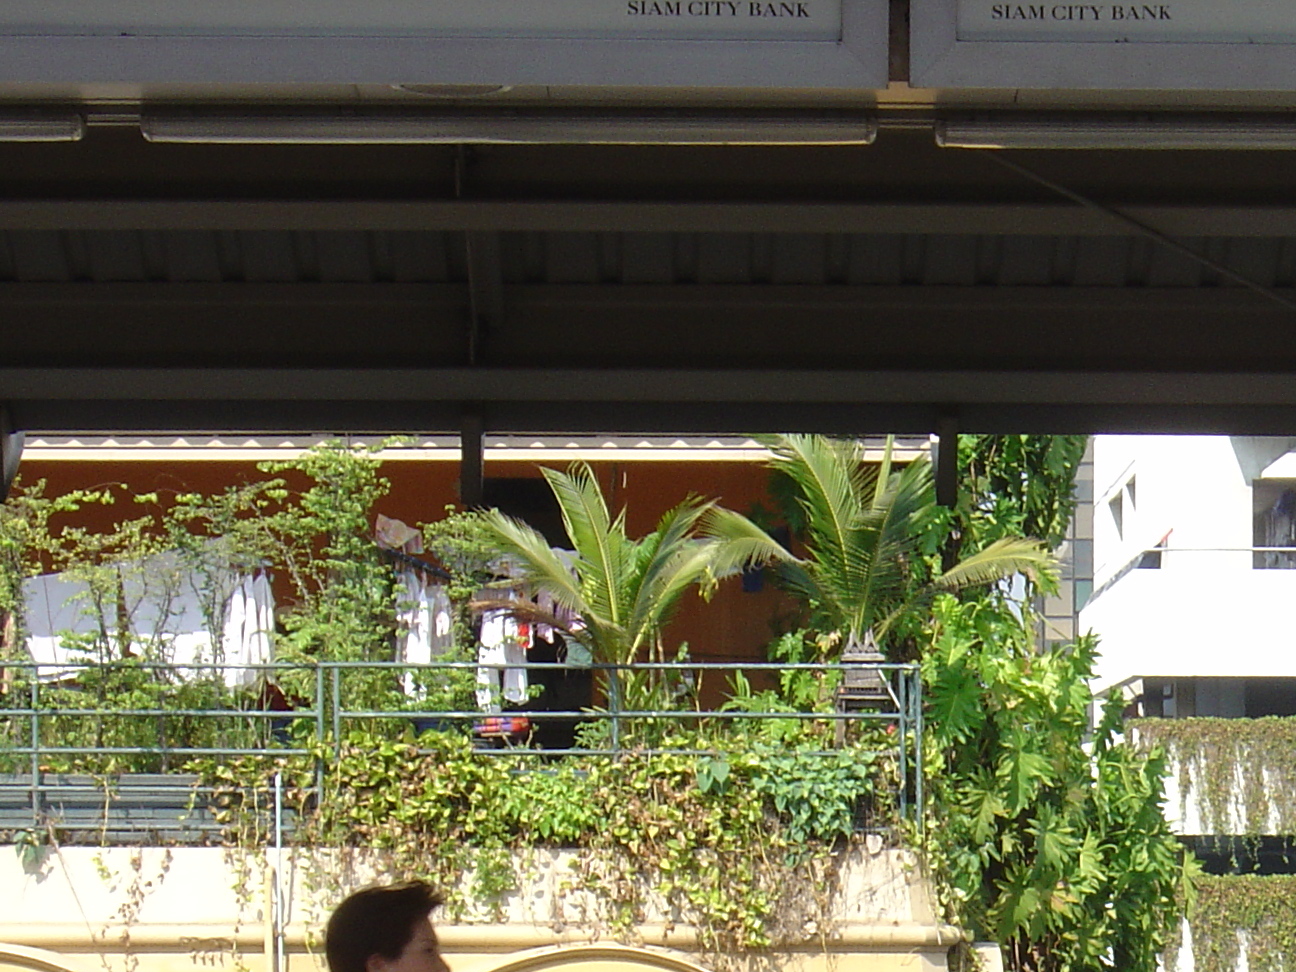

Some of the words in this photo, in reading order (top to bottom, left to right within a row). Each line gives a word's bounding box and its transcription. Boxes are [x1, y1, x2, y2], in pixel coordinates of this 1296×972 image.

[627, 1, 681, 16] SIAM
[688, 1, 741, 17] CITY
[750, 2, 810, 18] BANK
[992, 5, 1045, 20] SIAM
[1052, 5, 1103, 20] CITY
[1112, 5, 1171, 20] BANK
